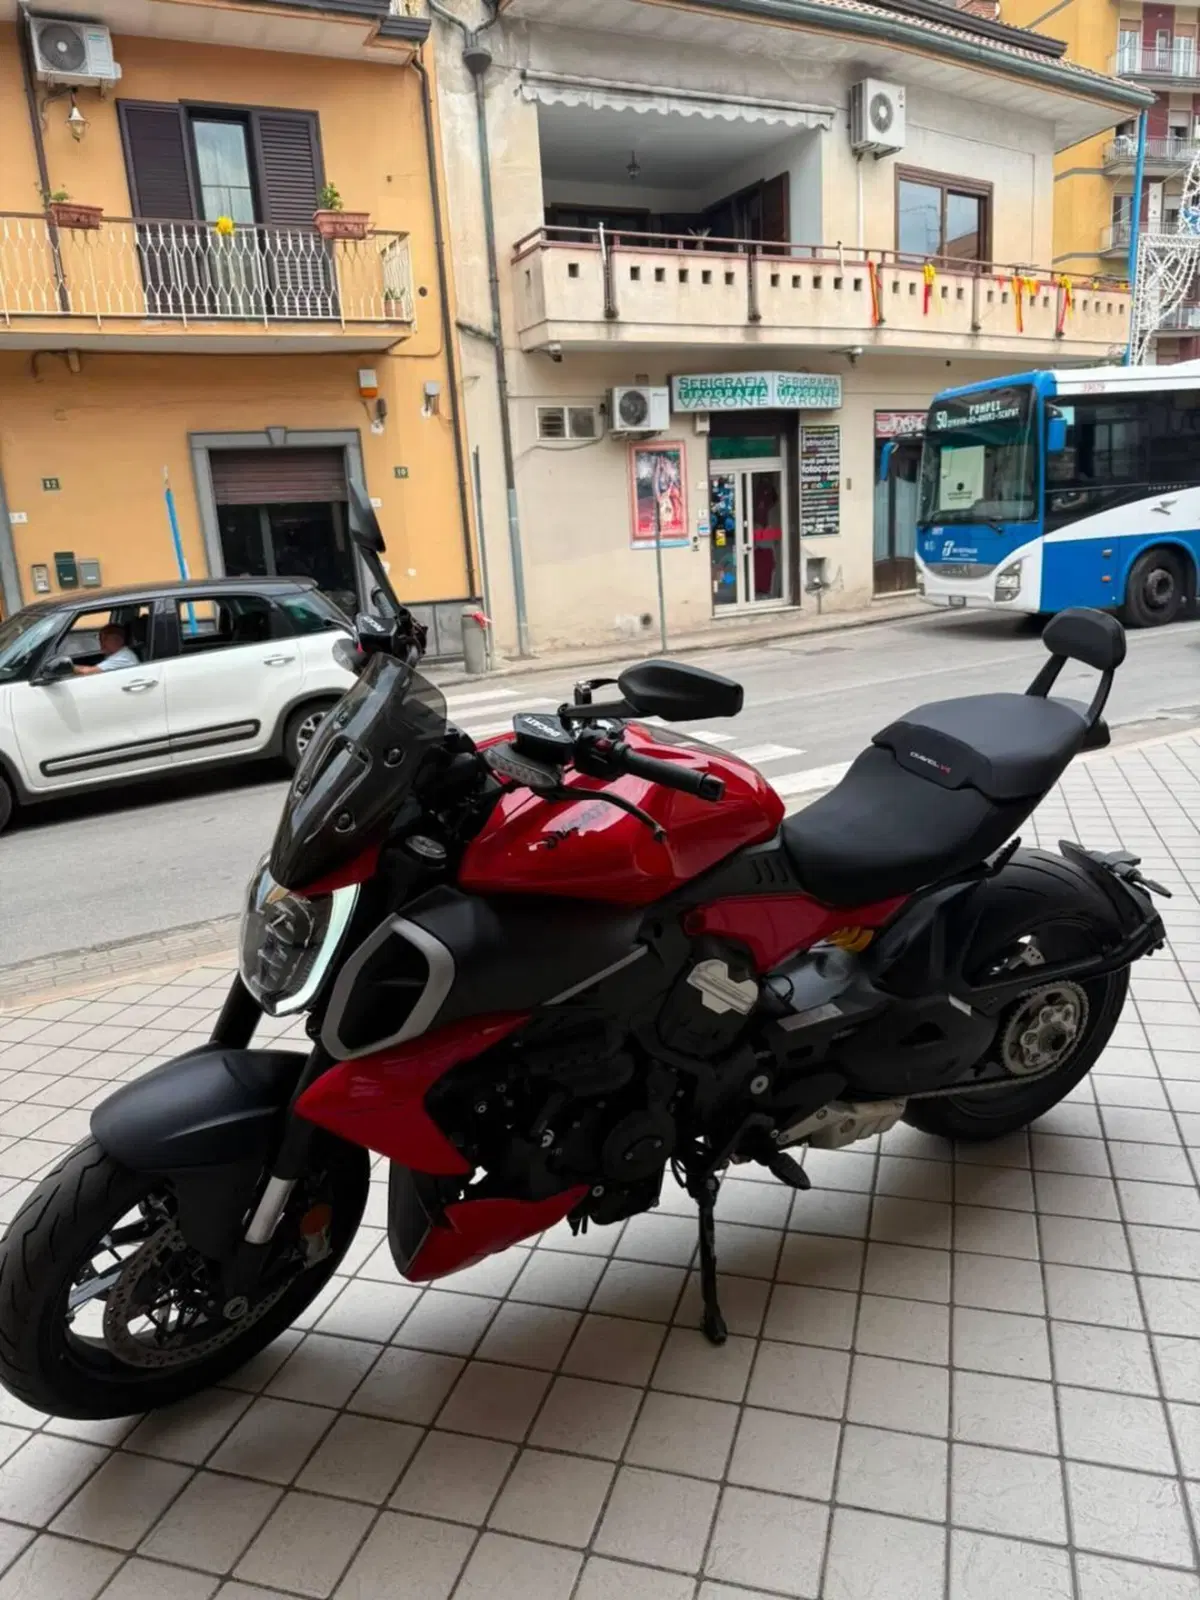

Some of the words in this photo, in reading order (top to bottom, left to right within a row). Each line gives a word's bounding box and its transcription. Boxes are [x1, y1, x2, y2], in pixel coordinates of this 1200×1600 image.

[678, 375, 768, 389] SERIGRAFIA
[778, 375, 838, 387] SERIGRAFIA
[679, 386, 768, 398] TIPOGRAFIA
[680, 395, 768, 408] VARONE
[779, 395, 839, 406] VARONE
[936, 410, 948, 429] 50
